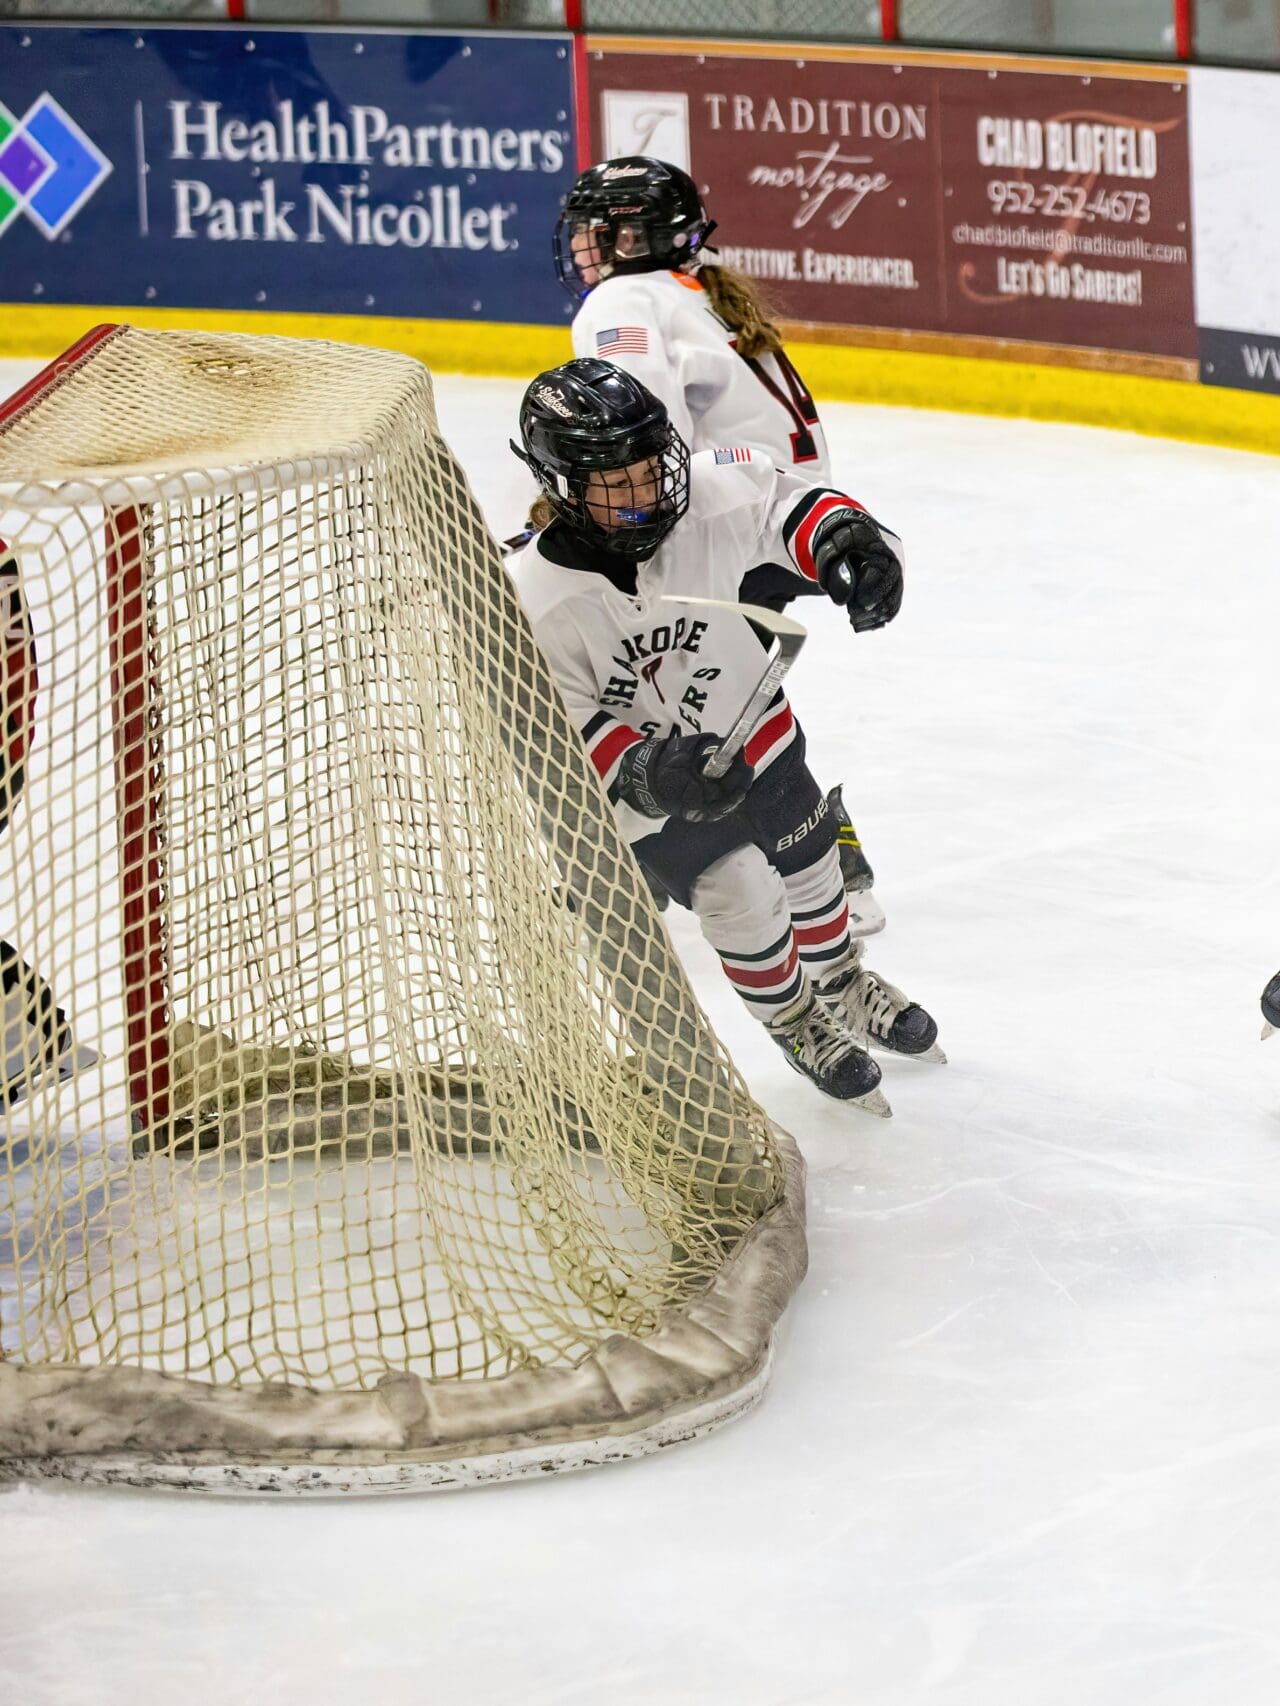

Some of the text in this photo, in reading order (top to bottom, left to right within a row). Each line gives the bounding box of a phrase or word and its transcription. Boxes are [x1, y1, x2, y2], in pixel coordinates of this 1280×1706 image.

[169, 99, 565, 174] HealthPartners
[704, 92, 928, 141] TRADITION
[977, 115, 1157, 179] CHAD BLOFIELD
[172, 179, 298, 242] Park
[748, 140, 892, 229] mortgage
